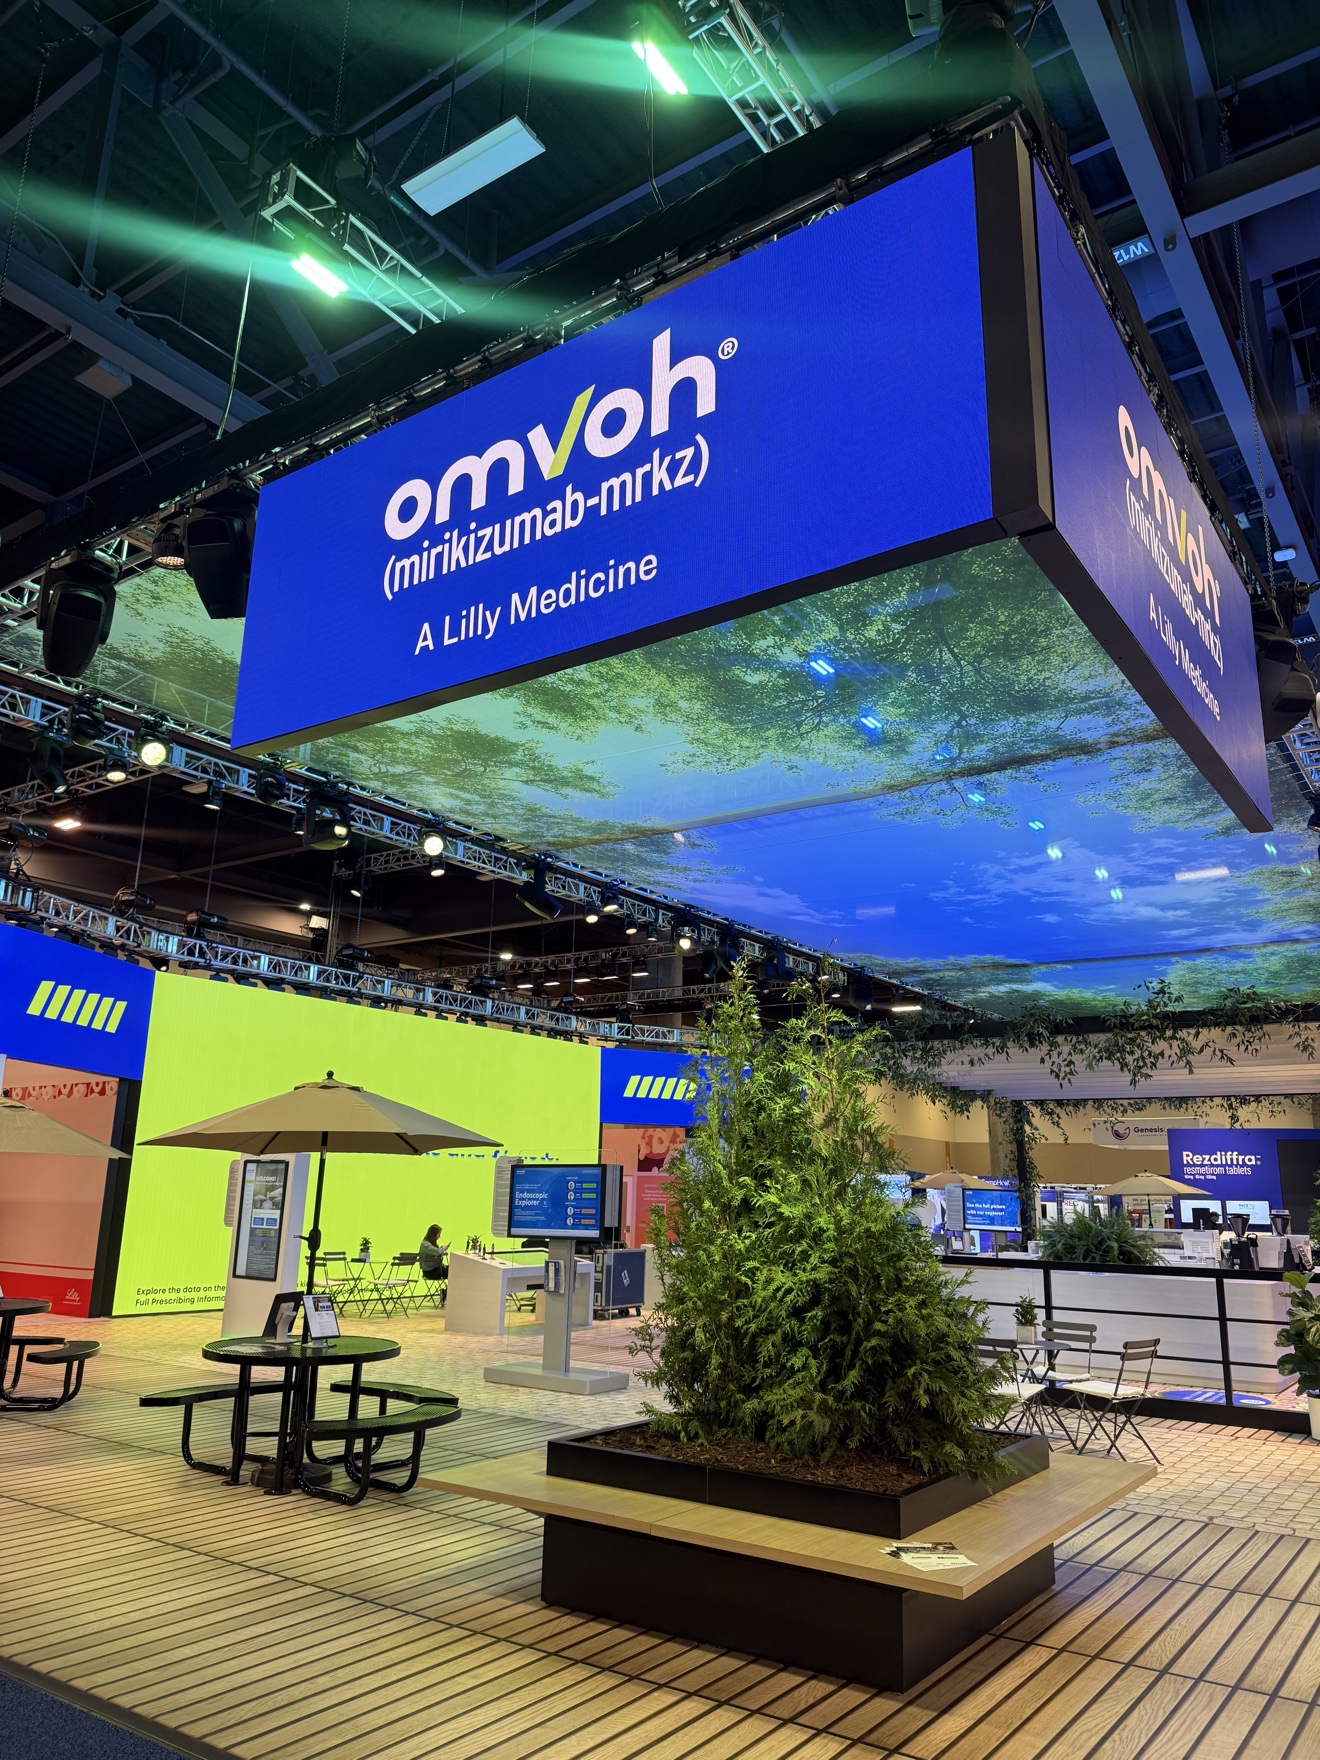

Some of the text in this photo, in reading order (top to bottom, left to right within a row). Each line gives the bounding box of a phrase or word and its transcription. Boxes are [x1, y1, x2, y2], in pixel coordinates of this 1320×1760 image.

[383, 433, 710, 601] (mirikizumab-mrkz)
[1126, 478, 1224, 676] (mirikizumab-mrkz)
[414, 553, 658, 656] A Lilly Medicine
[1150, 592, 1221, 722] A Lilly Medicine
[1184, 1165, 1252, 1175] resmetirom tablets
[515, 1191, 548, 1200] Endoscopic
[515, 1199, 540, 1207] Explorer
[136, 1287, 166, 1296] Explore
[168, 1286, 181, 1294] the
[183, 1285, 201, 1293] data
[213, 1284, 226, 1292] the
[135, 1298, 150, 1306] Full
[151, 1297, 195, 1305] Prescribing
